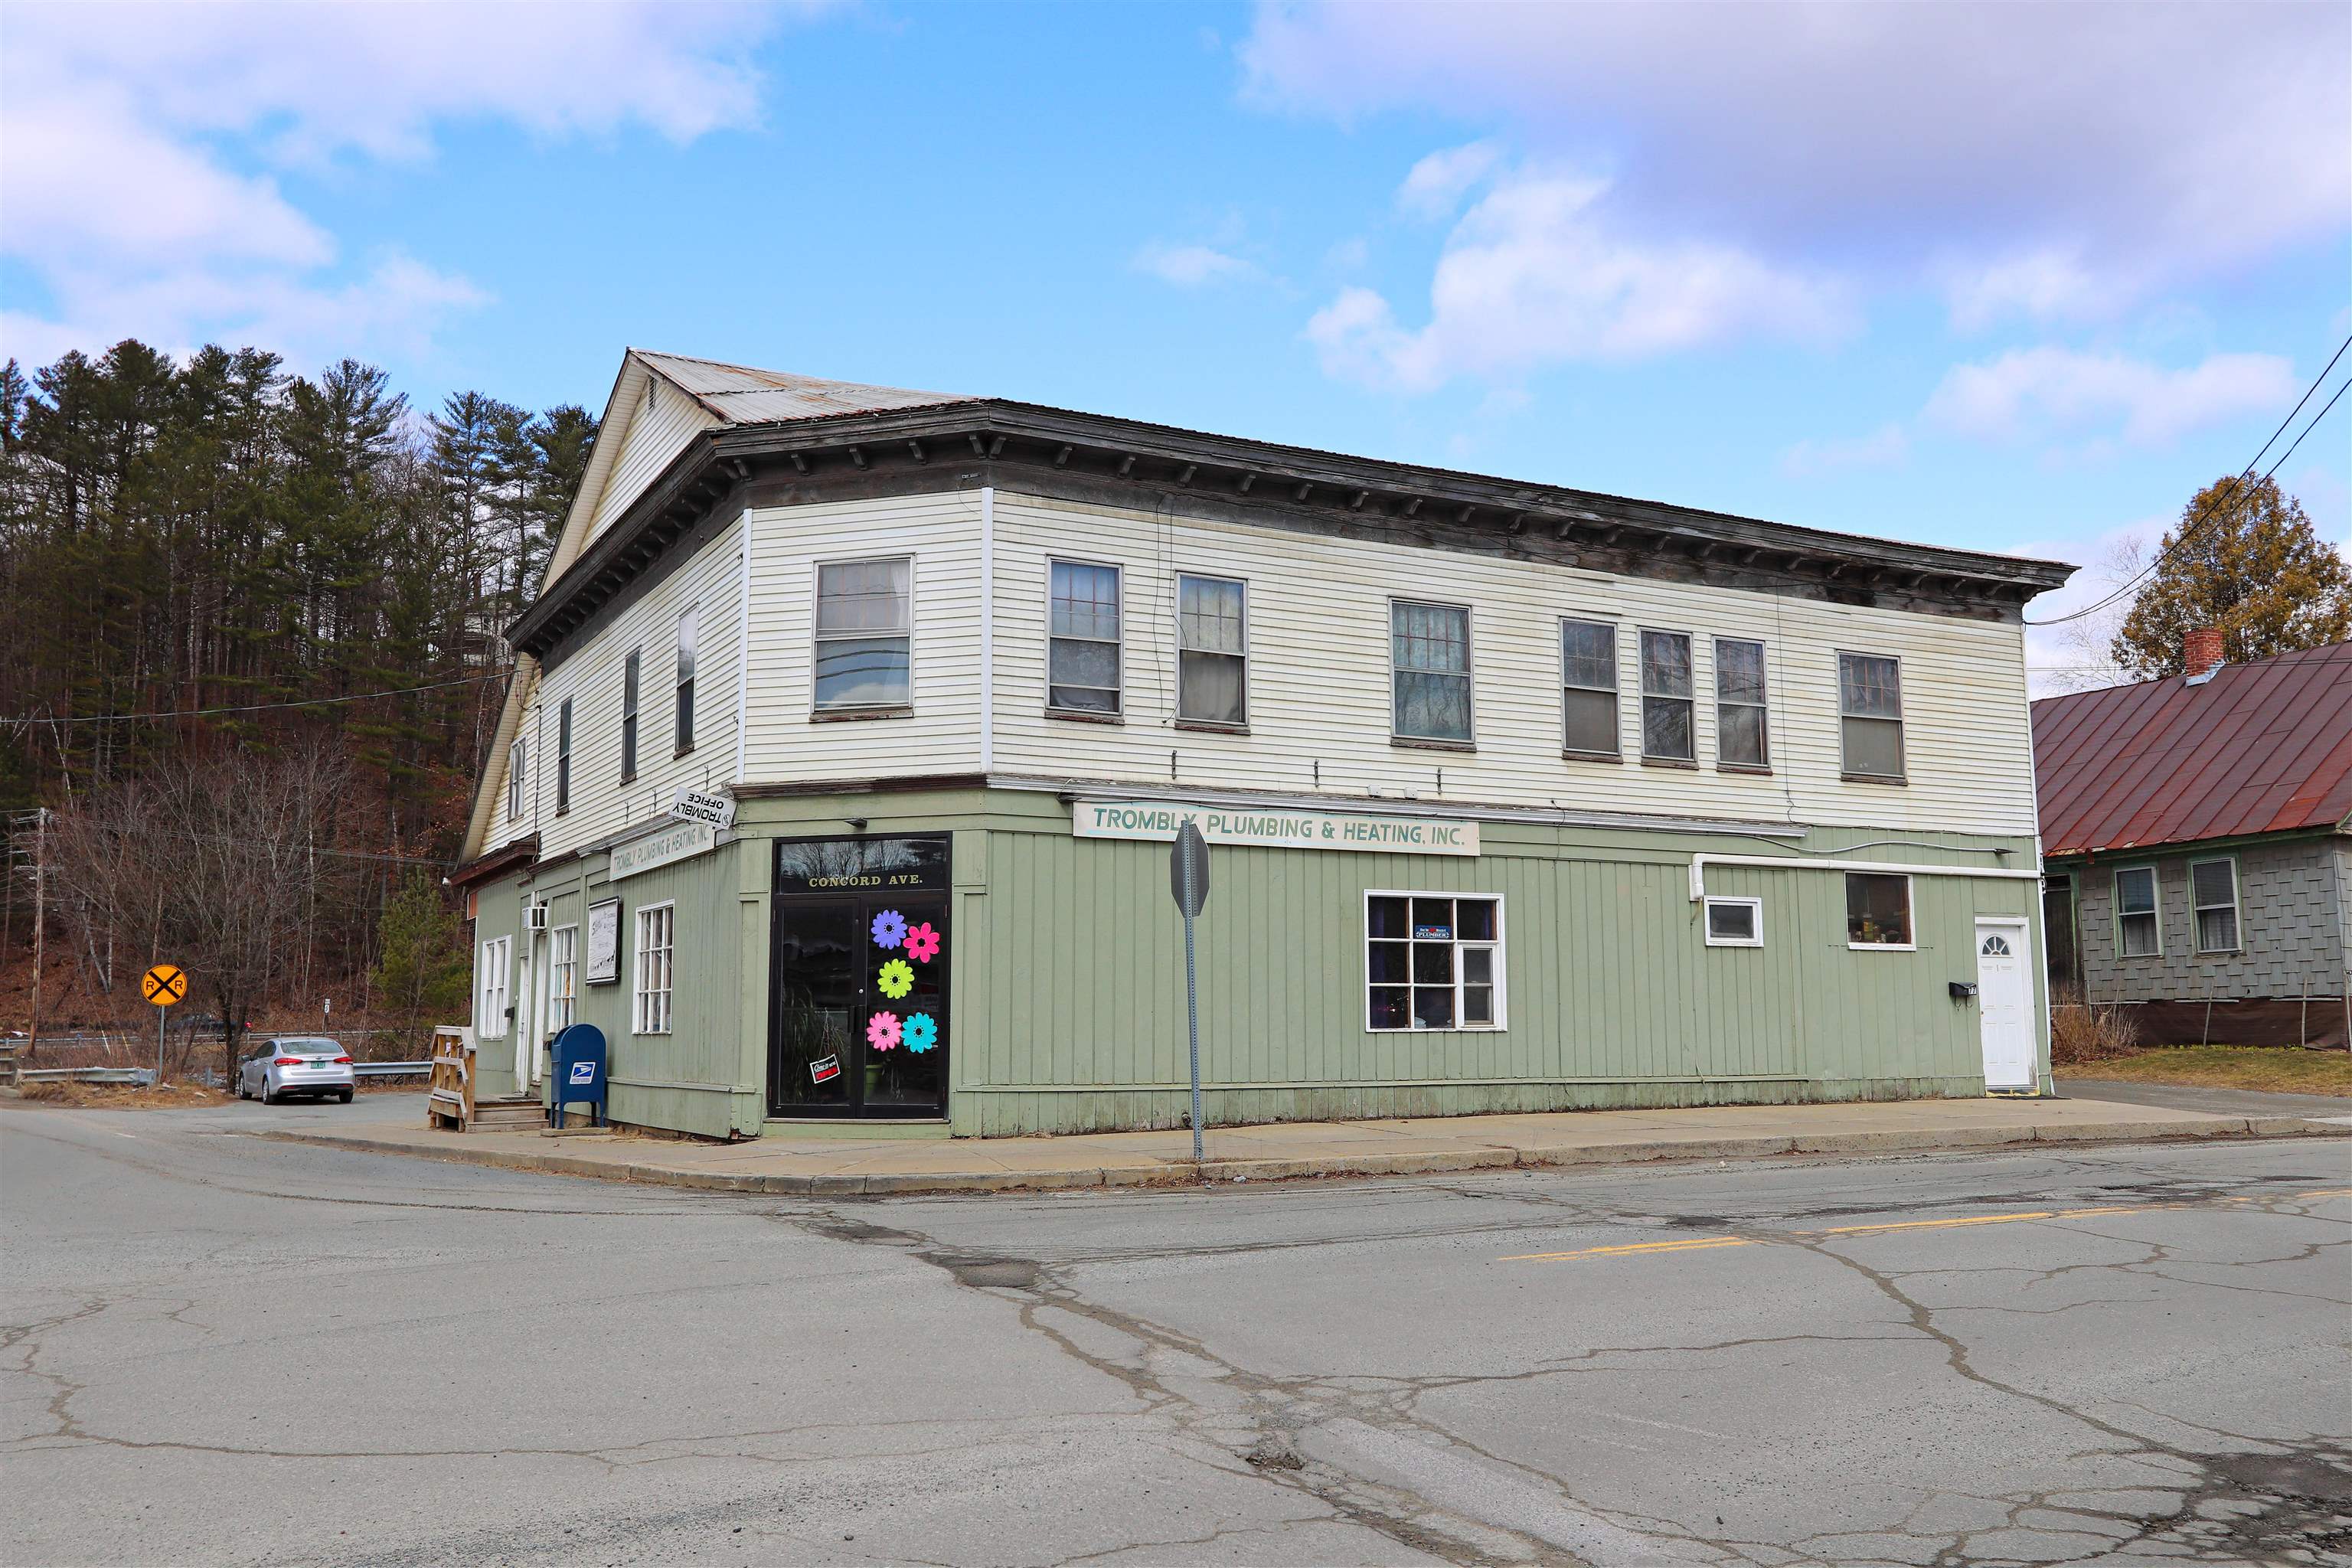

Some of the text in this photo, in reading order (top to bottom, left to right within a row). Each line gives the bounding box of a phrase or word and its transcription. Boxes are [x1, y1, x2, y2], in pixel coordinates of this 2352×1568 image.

[688, 793, 724, 809] OFFICE
[672, 802, 721, 823] TROMBLY
[1207, 814, 1312, 838] PLUMBING
[1321, 821, 1334, 839] &
[1431, 827, 1465, 845] INC.
[614, 849, 637, 871] TROMBLY
[637, 839, 664, 863] PLUMBING
[665, 838, 671, 854] &
[808, 874, 923, 887] CONCORD AVE.
